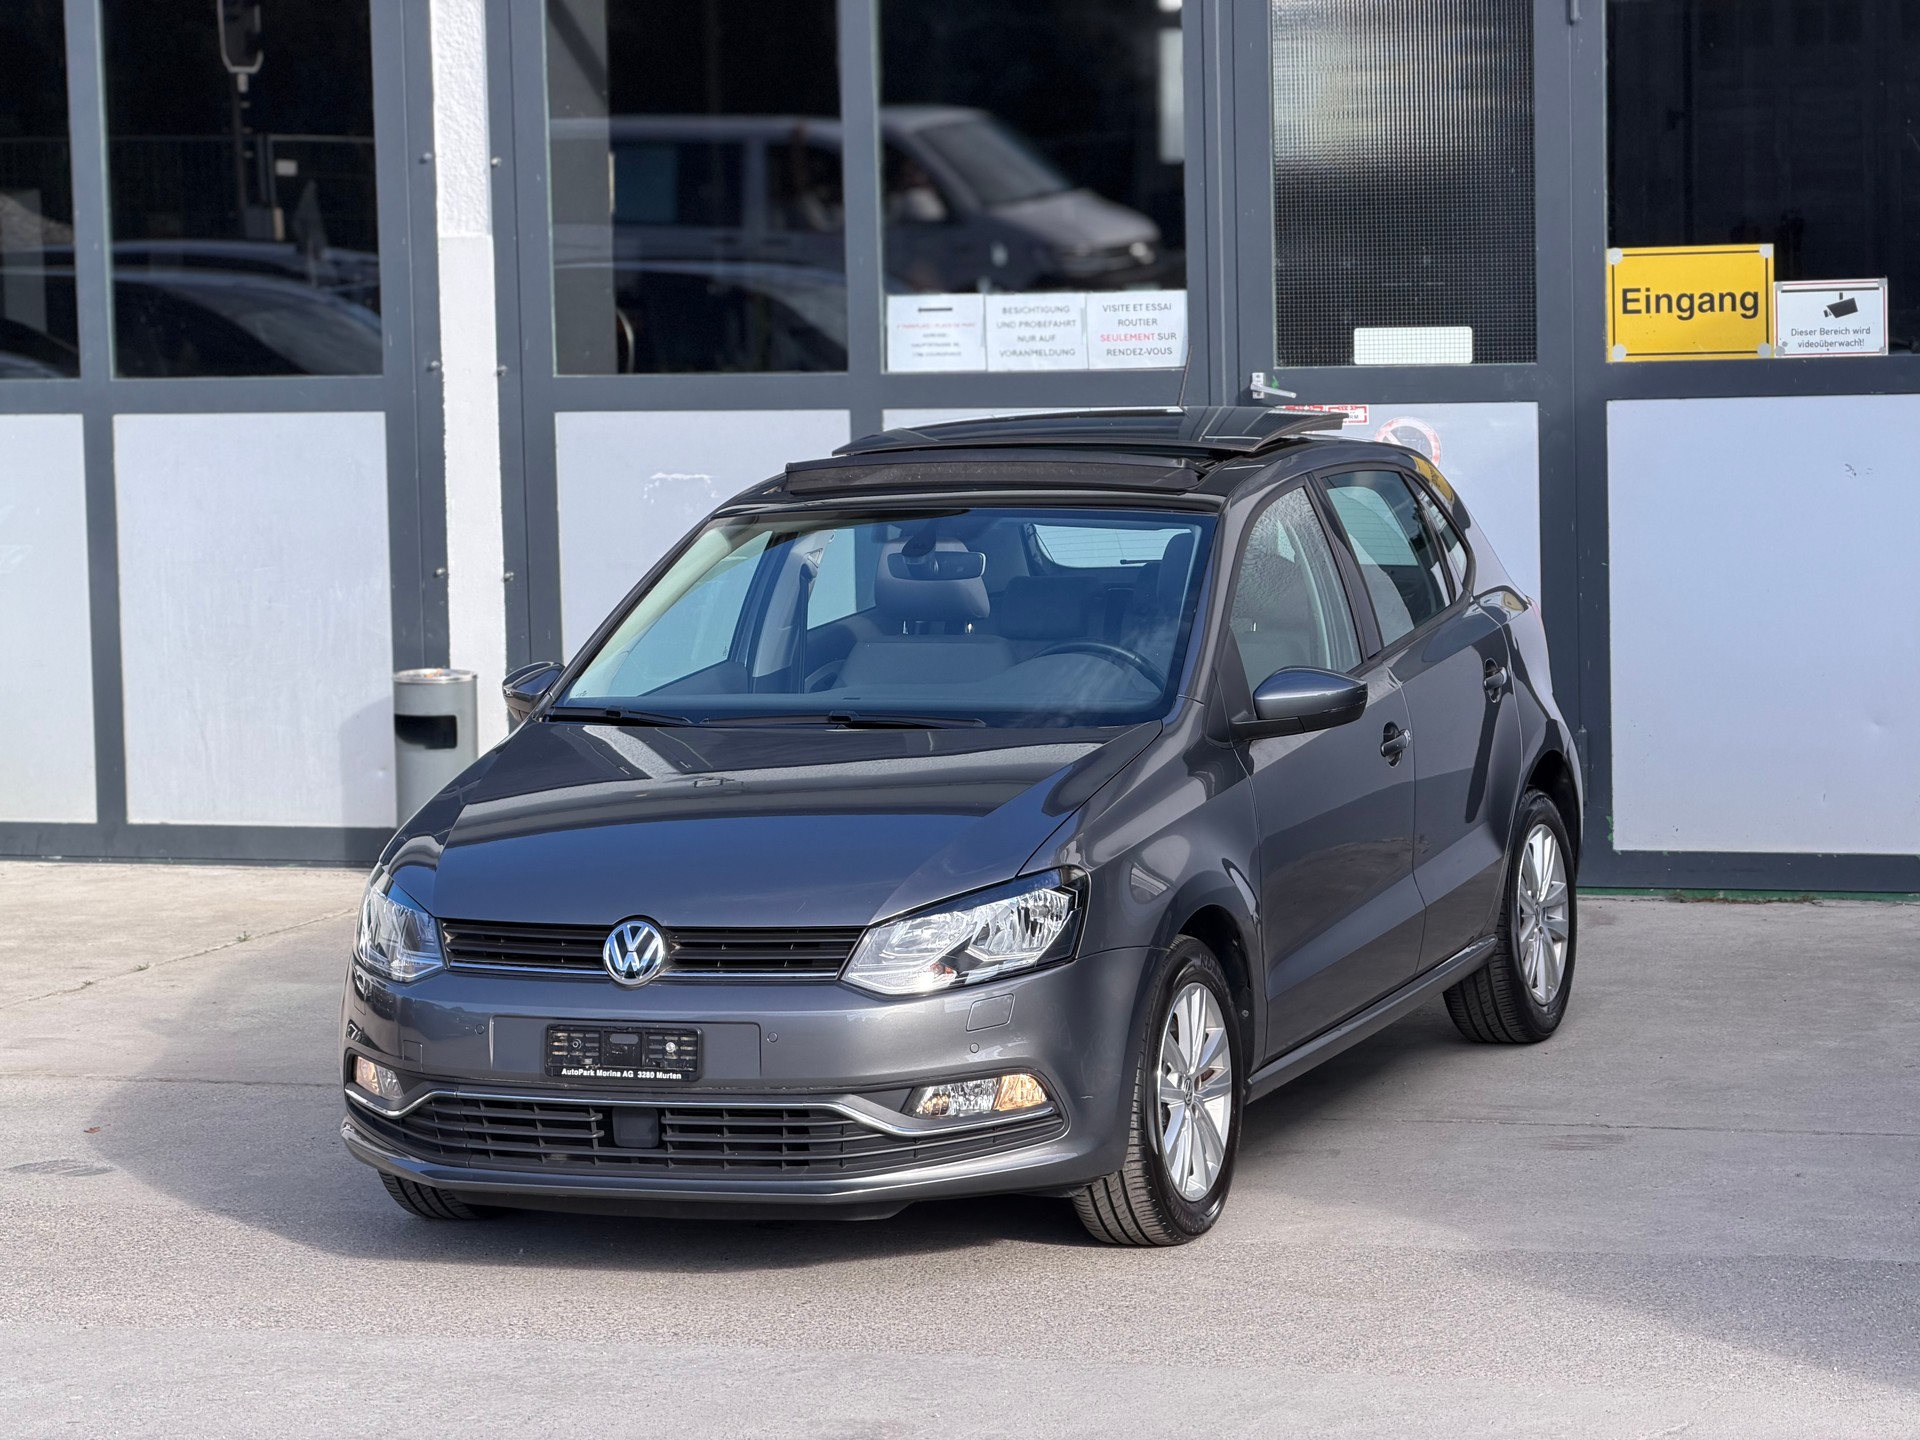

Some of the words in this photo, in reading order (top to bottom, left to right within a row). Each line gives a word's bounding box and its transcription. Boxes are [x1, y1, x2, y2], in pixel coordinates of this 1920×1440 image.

[1102, 303, 1130, 313] VISITE
[1132, 303, 1143, 312] ET
[1145, 302, 1172, 312] ESSAI
[1621, 287, 1759, 321] Eingang
[1001, 305, 1070, 315] BESICHTIGUNG
[996, 320, 1016, 329] UND
[1018, 319, 1076, 329] PROBEFAHRT
[1117, 318, 1158, 327] ROUTIER
[1790, 327, 1817, 337] Dieser
[1819, 326, 1850, 336] Bereich
[1852, 326, 1871, 335] wird
[1017, 334, 1037, 343] NUR
[1038, 334, 1056, 343] AUF
[1100, 332, 1155, 342] SEULEMENT
[1157, 332, 1177, 341] SUR
[1797, 337, 1865, 348] videoüberwacht!
[998, 348, 1076, 358] VORANMELDUNG
[1106, 347, 1173, 357] RENDEZ-VOUS
[603, 921, 664, 985] VW
[561, 1067, 595, 1077] AutoPark
[596, 1069, 621, 1078] Morina
[622, 1070, 634, 1078] AG
[656, 1071, 682, 1080] Murten
